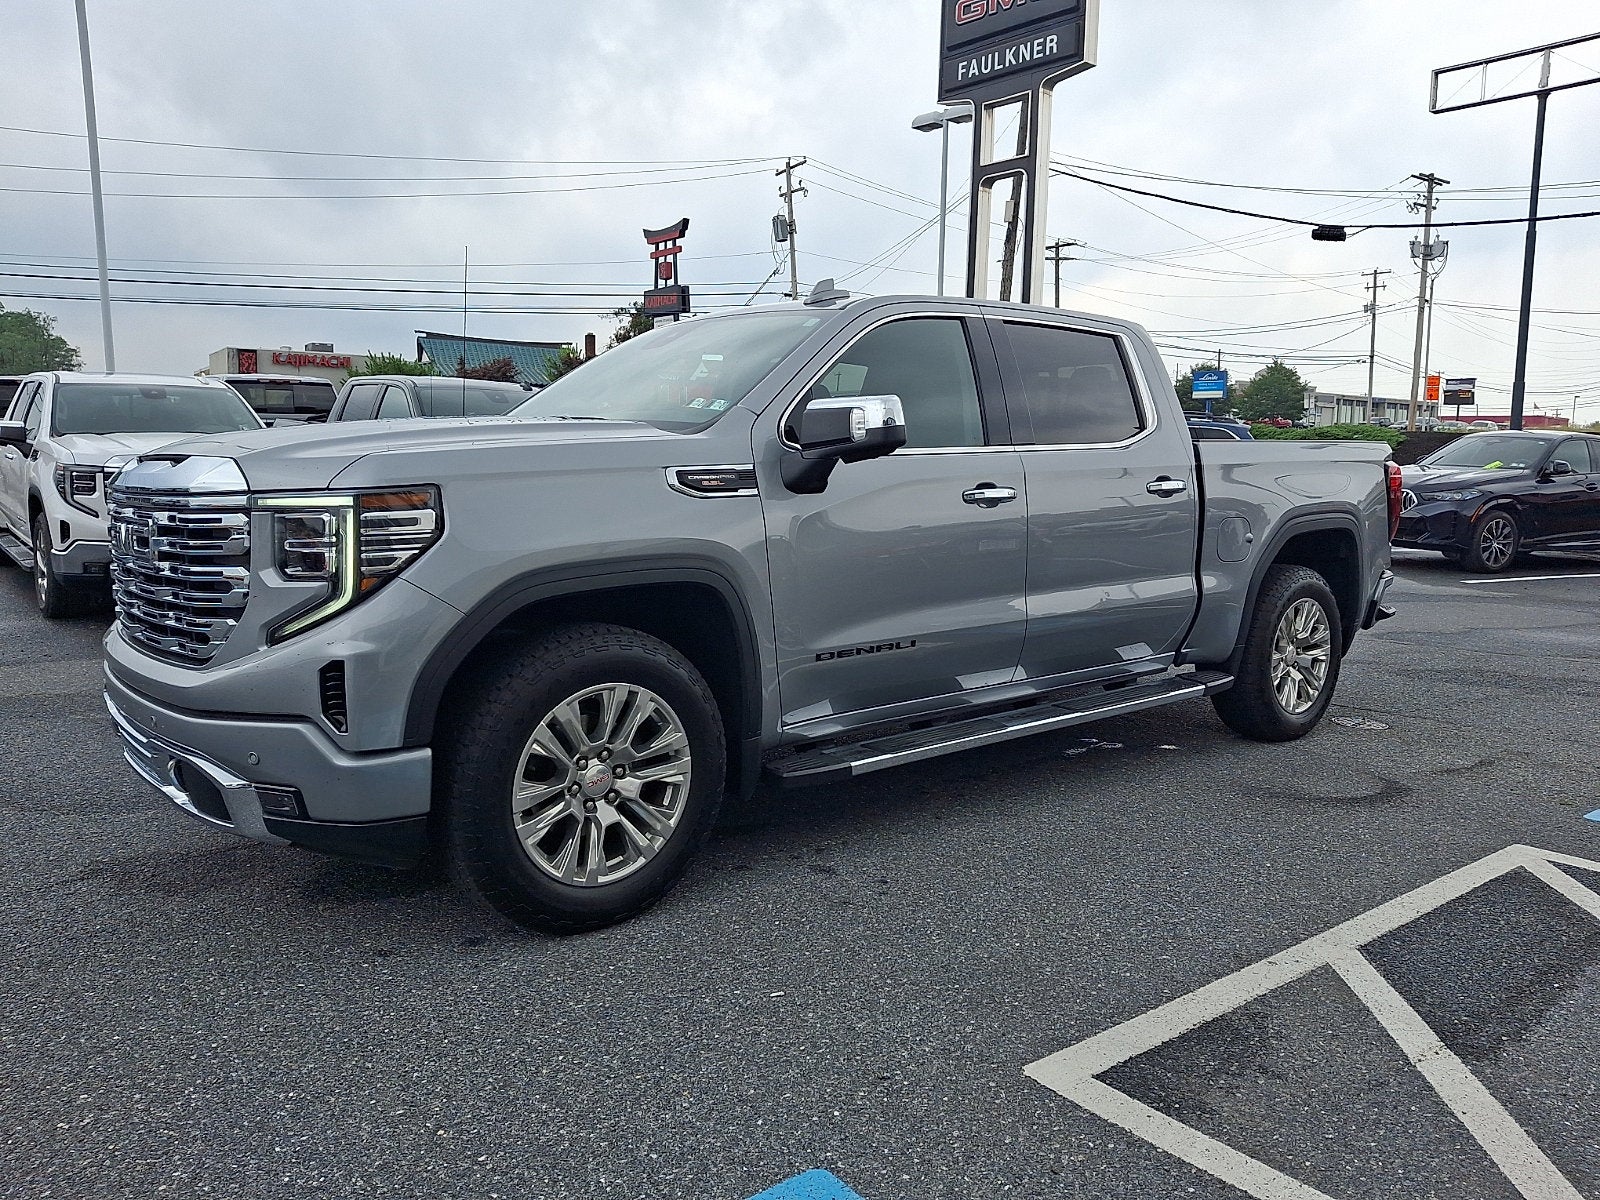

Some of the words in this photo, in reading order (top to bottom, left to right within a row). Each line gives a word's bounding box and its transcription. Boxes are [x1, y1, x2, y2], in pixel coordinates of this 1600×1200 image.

[957, 34, 1058, 81] FAULKNER
[272, 352, 352, 368] KAJIMACHI
[815, 639, 917, 662] DENALI
